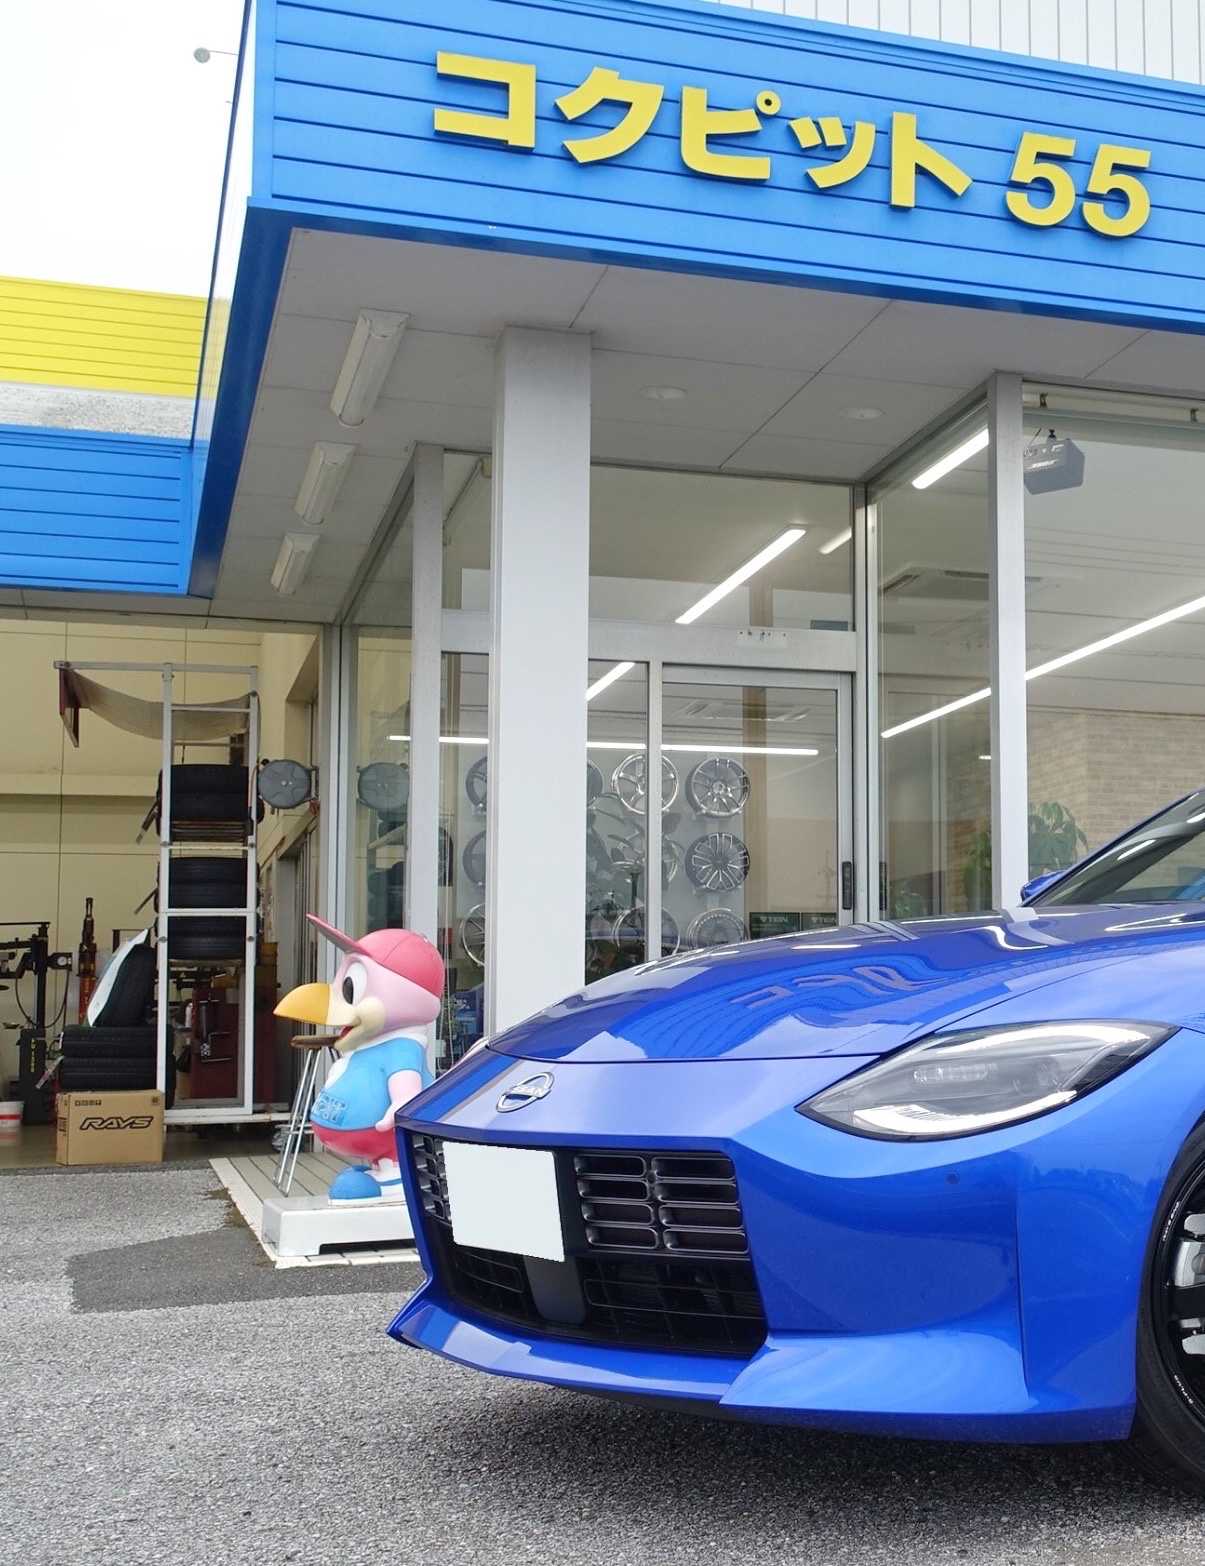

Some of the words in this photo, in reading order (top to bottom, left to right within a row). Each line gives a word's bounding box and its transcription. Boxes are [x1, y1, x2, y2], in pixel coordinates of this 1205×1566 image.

[434, 50, 972, 209] コクピット
[1005, 131, 1152, 237] 55
[79, 1115, 154, 1131] RAYS
